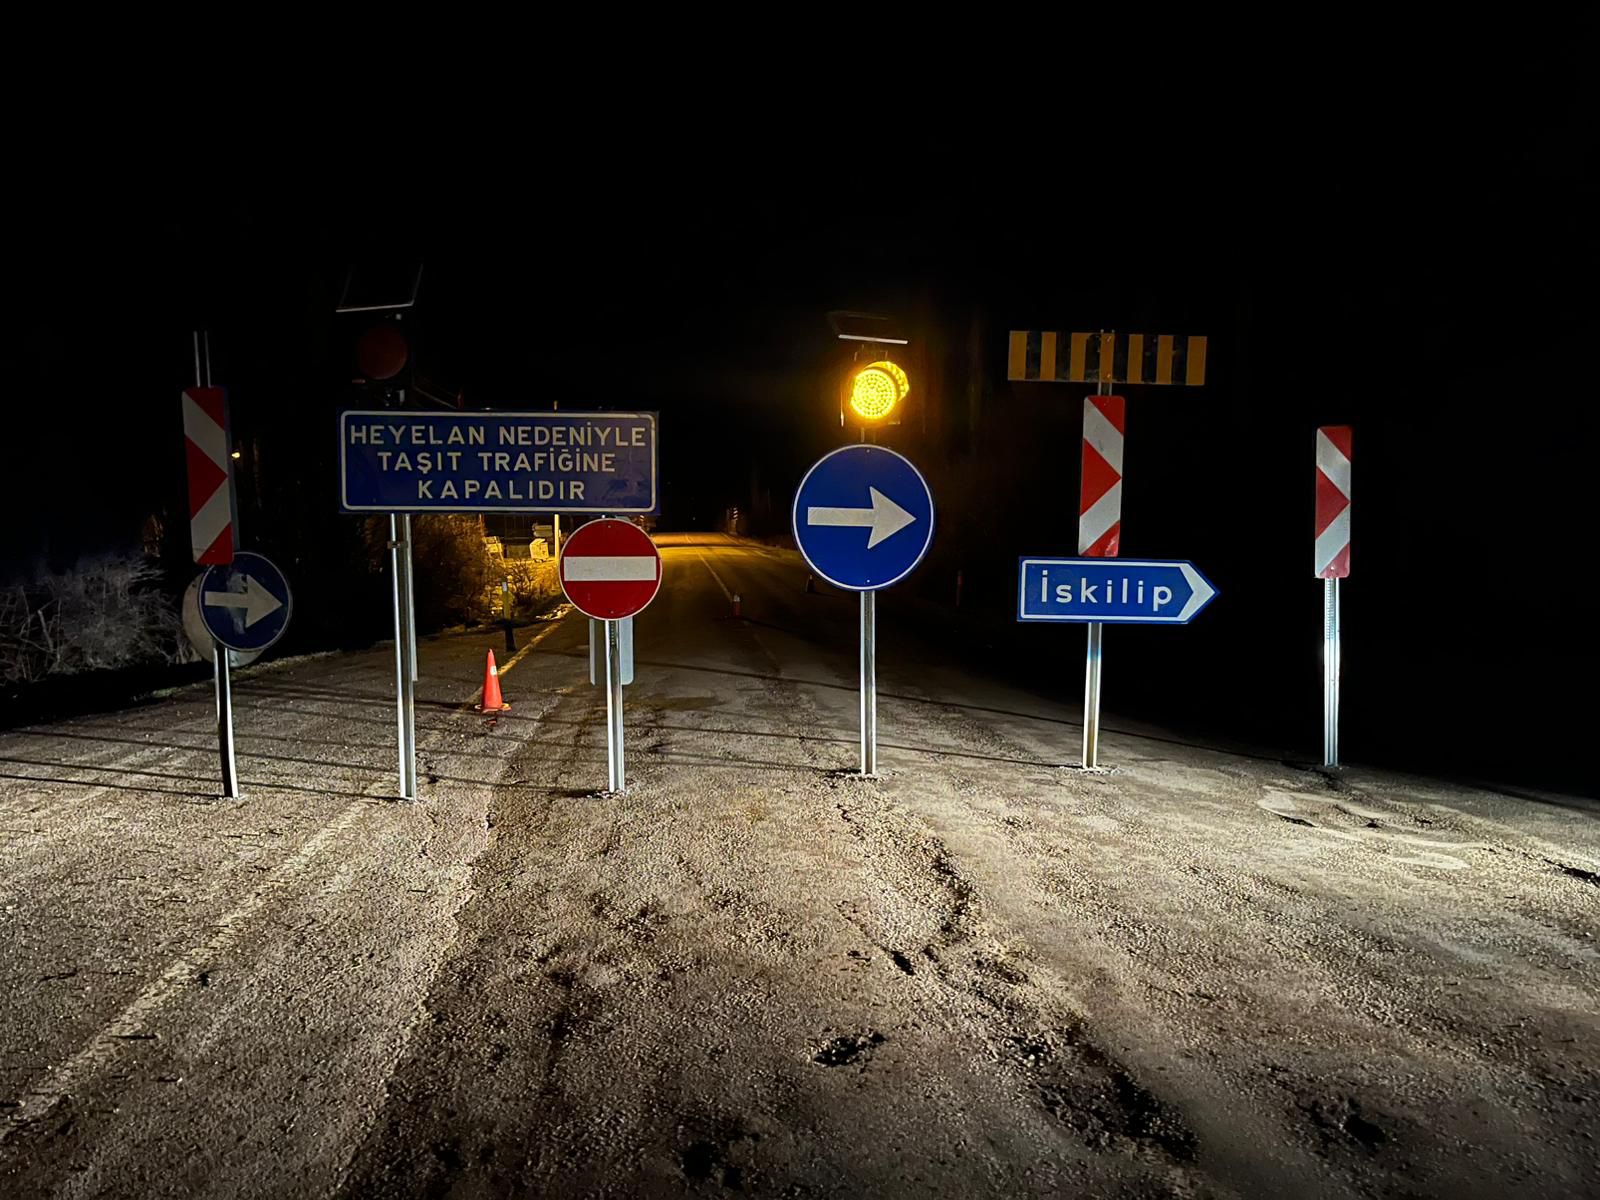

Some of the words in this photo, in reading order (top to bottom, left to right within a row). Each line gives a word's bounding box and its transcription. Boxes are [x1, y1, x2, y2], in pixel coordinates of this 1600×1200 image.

[350, 425, 485, 445] HEYELAN
[499, 422, 646, 447] NEDENİYLE
[377, 452, 462, 475] TAŞIT
[478, 448, 616, 472] TRAFİĞİNE
[418, 480, 585, 500] KAPALIDIR
[1041, 570, 1172, 611] İskilip
